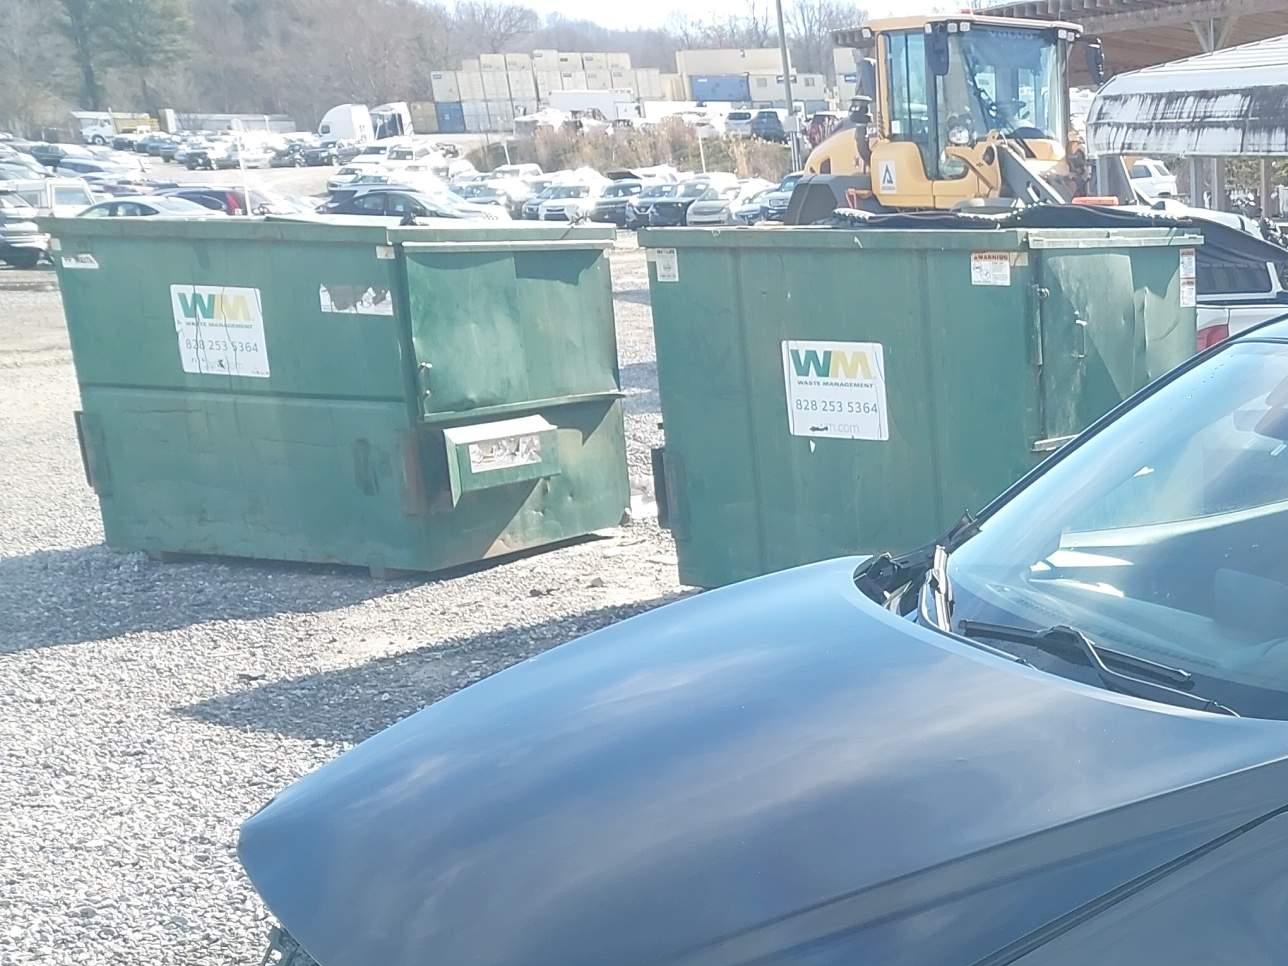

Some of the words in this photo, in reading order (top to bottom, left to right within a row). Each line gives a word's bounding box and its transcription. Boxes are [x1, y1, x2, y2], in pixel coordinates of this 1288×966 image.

[177, 292, 255, 321] WM
[185, 338, 206, 351] 828
[208, 339, 228, 351] 253
[231, 342, 258, 353] 5364
[789, 348, 873, 380] WM
[822, 381, 874, 389] MANAGEMENT
[795, 399, 818, 411] 828
[821, 400, 843, 413] 253
[847, 401, 878, 414] 5364
